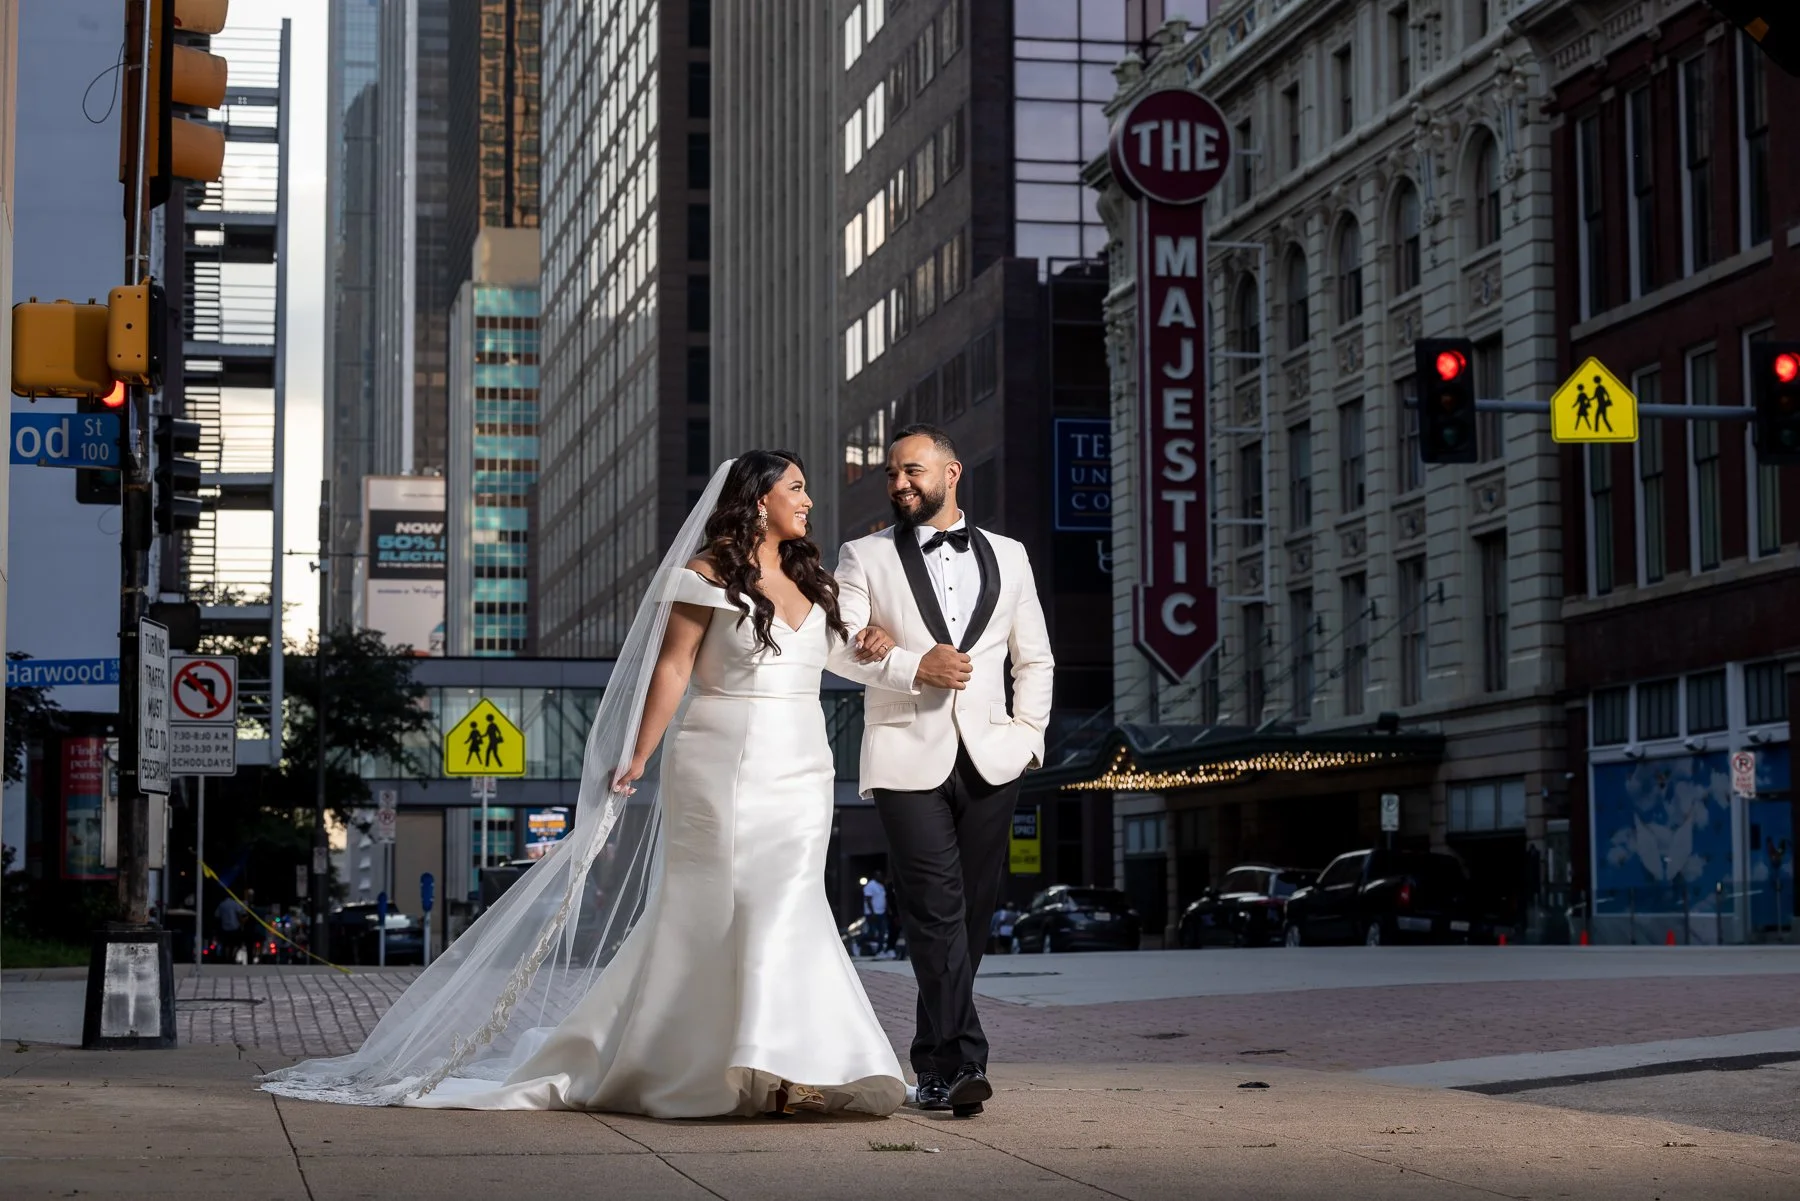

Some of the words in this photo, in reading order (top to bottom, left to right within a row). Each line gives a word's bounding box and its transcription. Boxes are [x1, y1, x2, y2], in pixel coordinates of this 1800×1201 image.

[1130, 119, 1220, 172] THE
[15, 417, 70, 459] od
[84, 418, 103, 437] St
[1070, 433, 1112, 459] TE
[1154, 235, 1197, 637] MAJESTIC
[80, 442, 110, 461] 100
[395, 522, 445, 534] NOW
[377, 535, 437, 551] 50%
[144, 632, 166, 659] TURNING
[6, 660, 105, 683] Harwood
[145, 663, 166, 689] TRAFFIC
[147, 696, 163, 720] MUST
[144, 727, 159, 750] YIELD
[160, 729, 167, 752] TO
